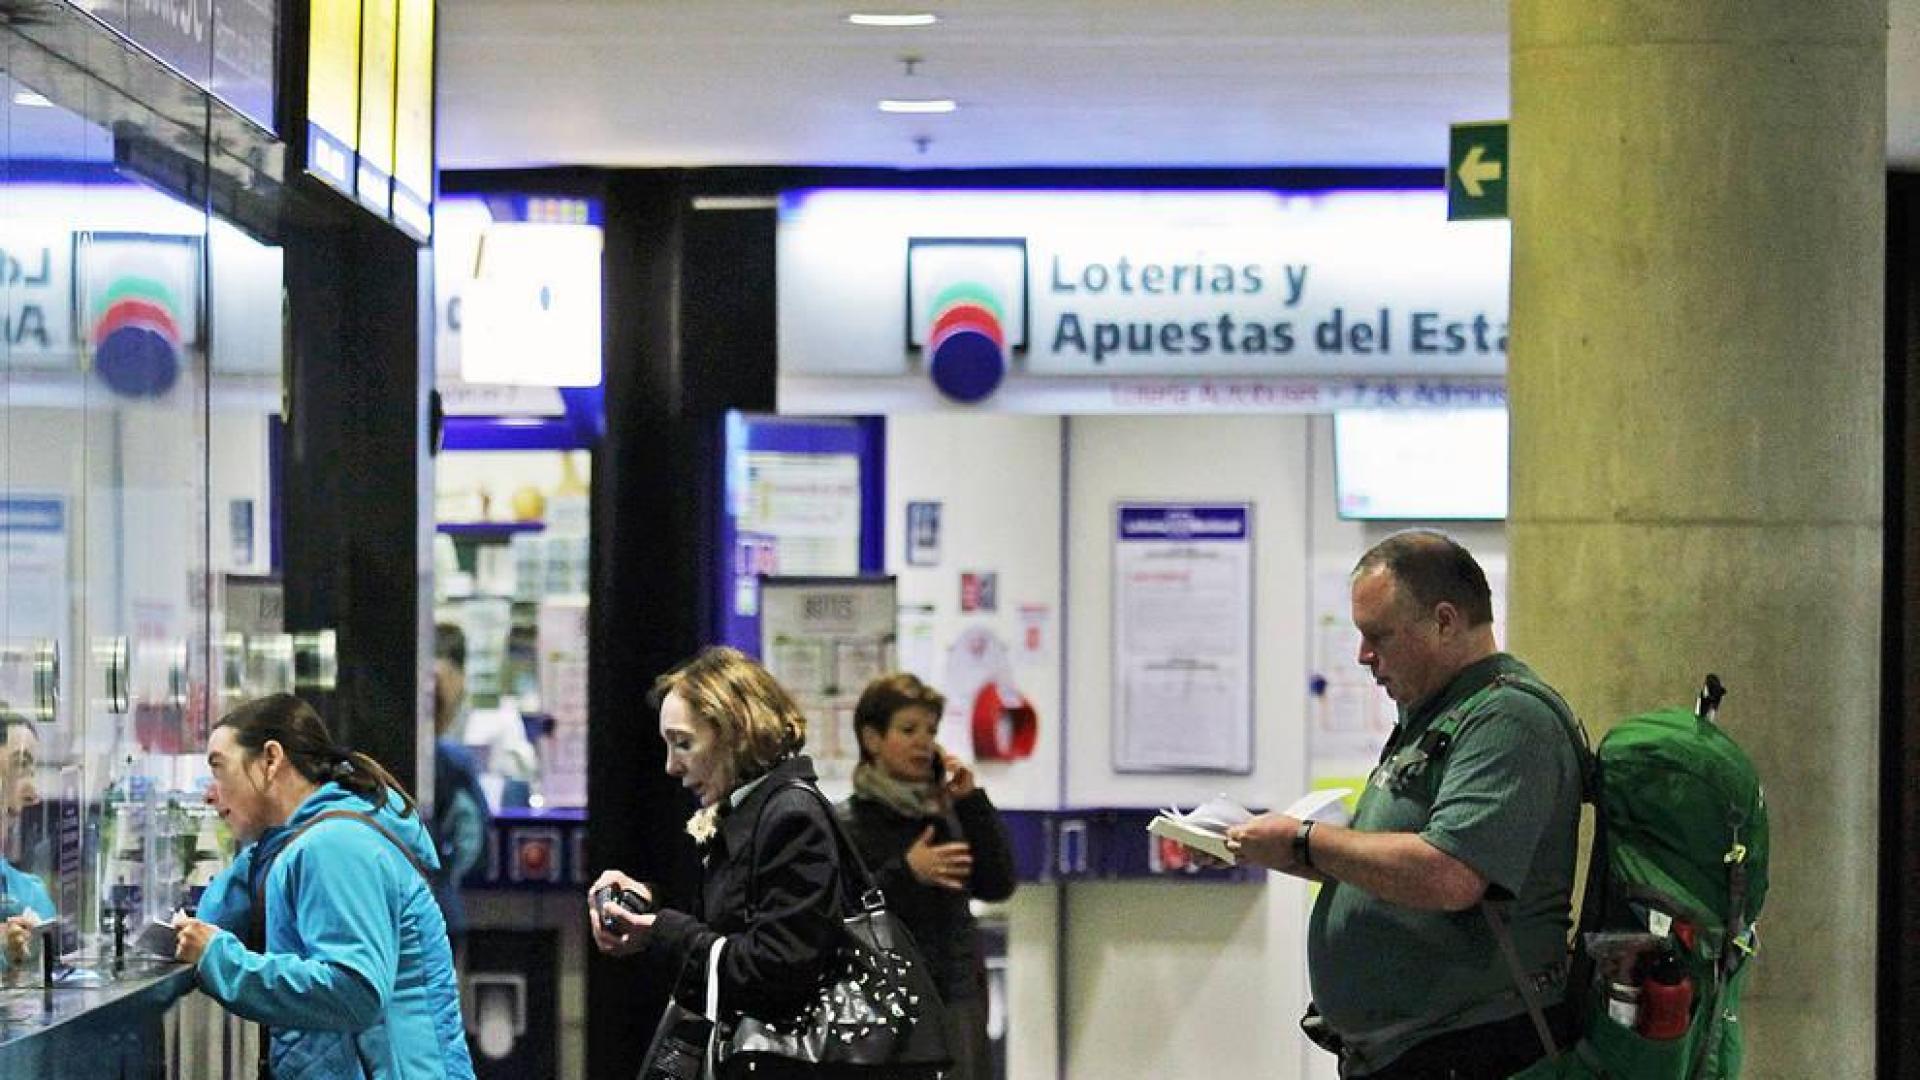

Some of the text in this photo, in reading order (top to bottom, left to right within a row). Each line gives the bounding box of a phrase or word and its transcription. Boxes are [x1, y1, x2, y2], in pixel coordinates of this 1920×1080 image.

[1284, 263, 1308, 304] y
[1052, 311, 1295, 361] Apuestas
[1315, 308, 1391, 353] del
